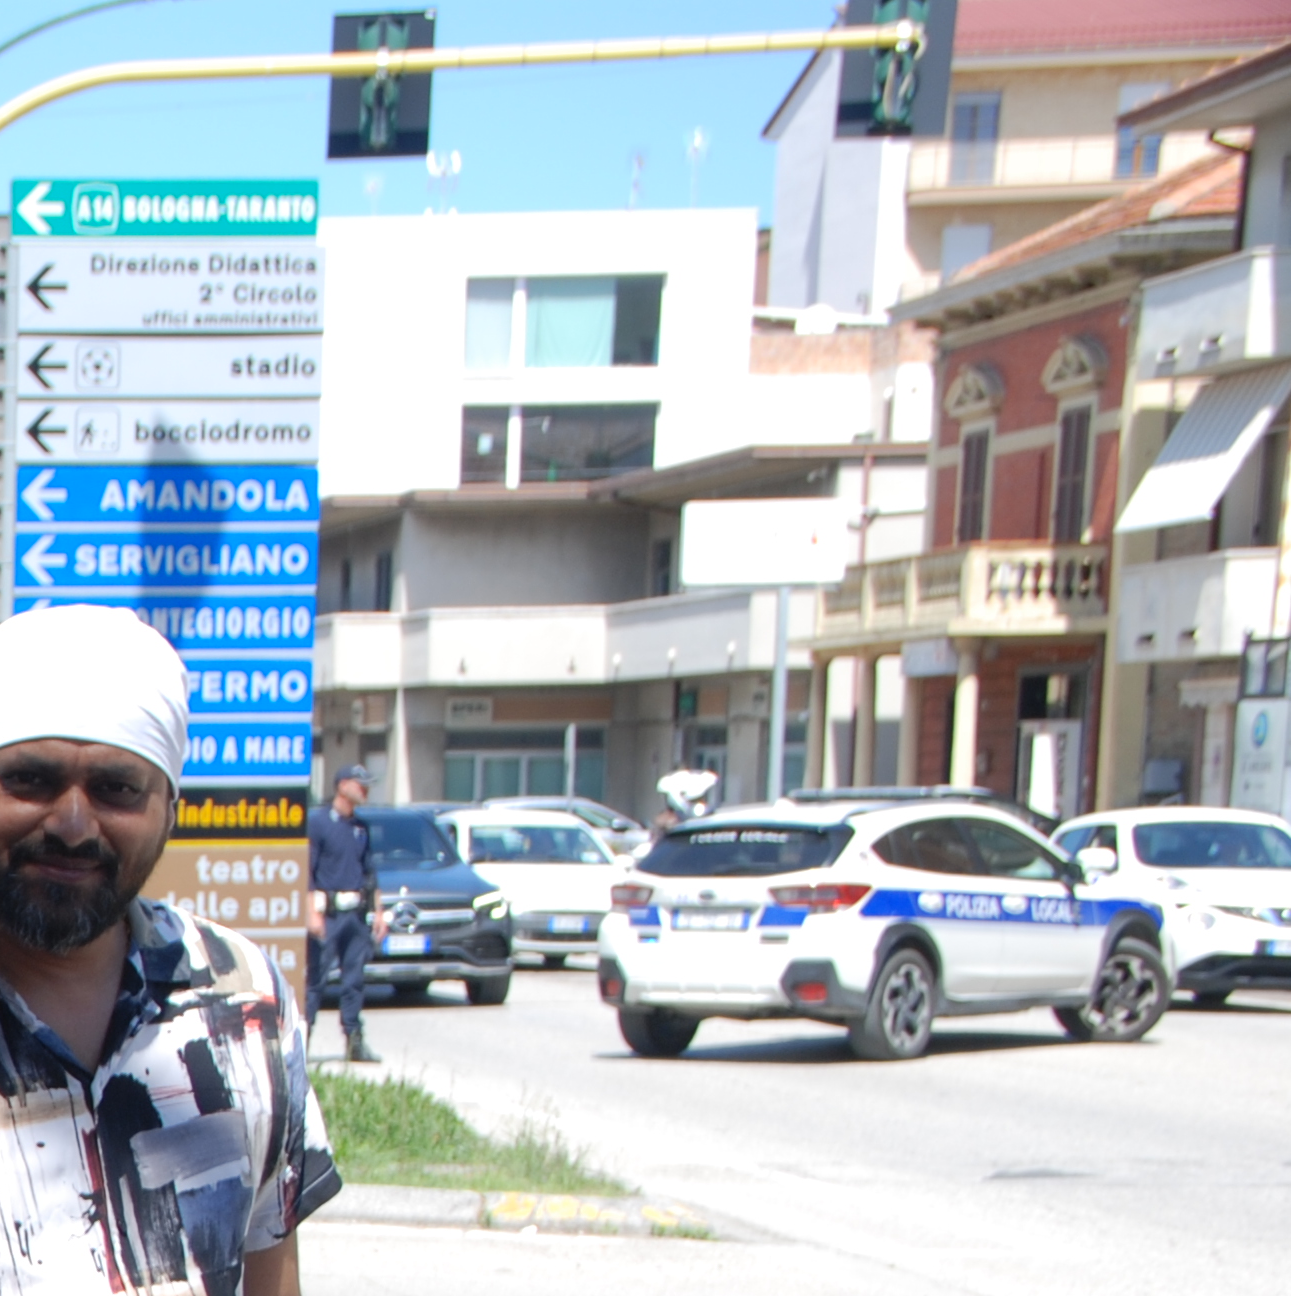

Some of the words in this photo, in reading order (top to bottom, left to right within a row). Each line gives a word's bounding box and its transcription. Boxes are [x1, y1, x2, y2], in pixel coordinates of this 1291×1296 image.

[91, 254, 200, 274] Direzione
[209, 254, 317, 274] Didattica
[233, 283, 317, 303] Circolo
[143, 310, 188, 327] uffici
[194, 310, 318, 327] amministrativi
[230, 355, 316, 377] stadio
[135, 420, 312, 444] bocciodromo
[100, 479, 310, 512] AMANDOLA
[74, 543, 309, 576] SERVIGLIANO
[188, 670, 308, 703] FERMO
[222, 736, 238, 764] A
[244, 735, 306, 764] MARE
[177, 797, 304, 828] industriale
[196, 855, 300, 885] teatro
[249, 890, 300, 925] api
[946, 894, 1000, 919] POLIZIA
